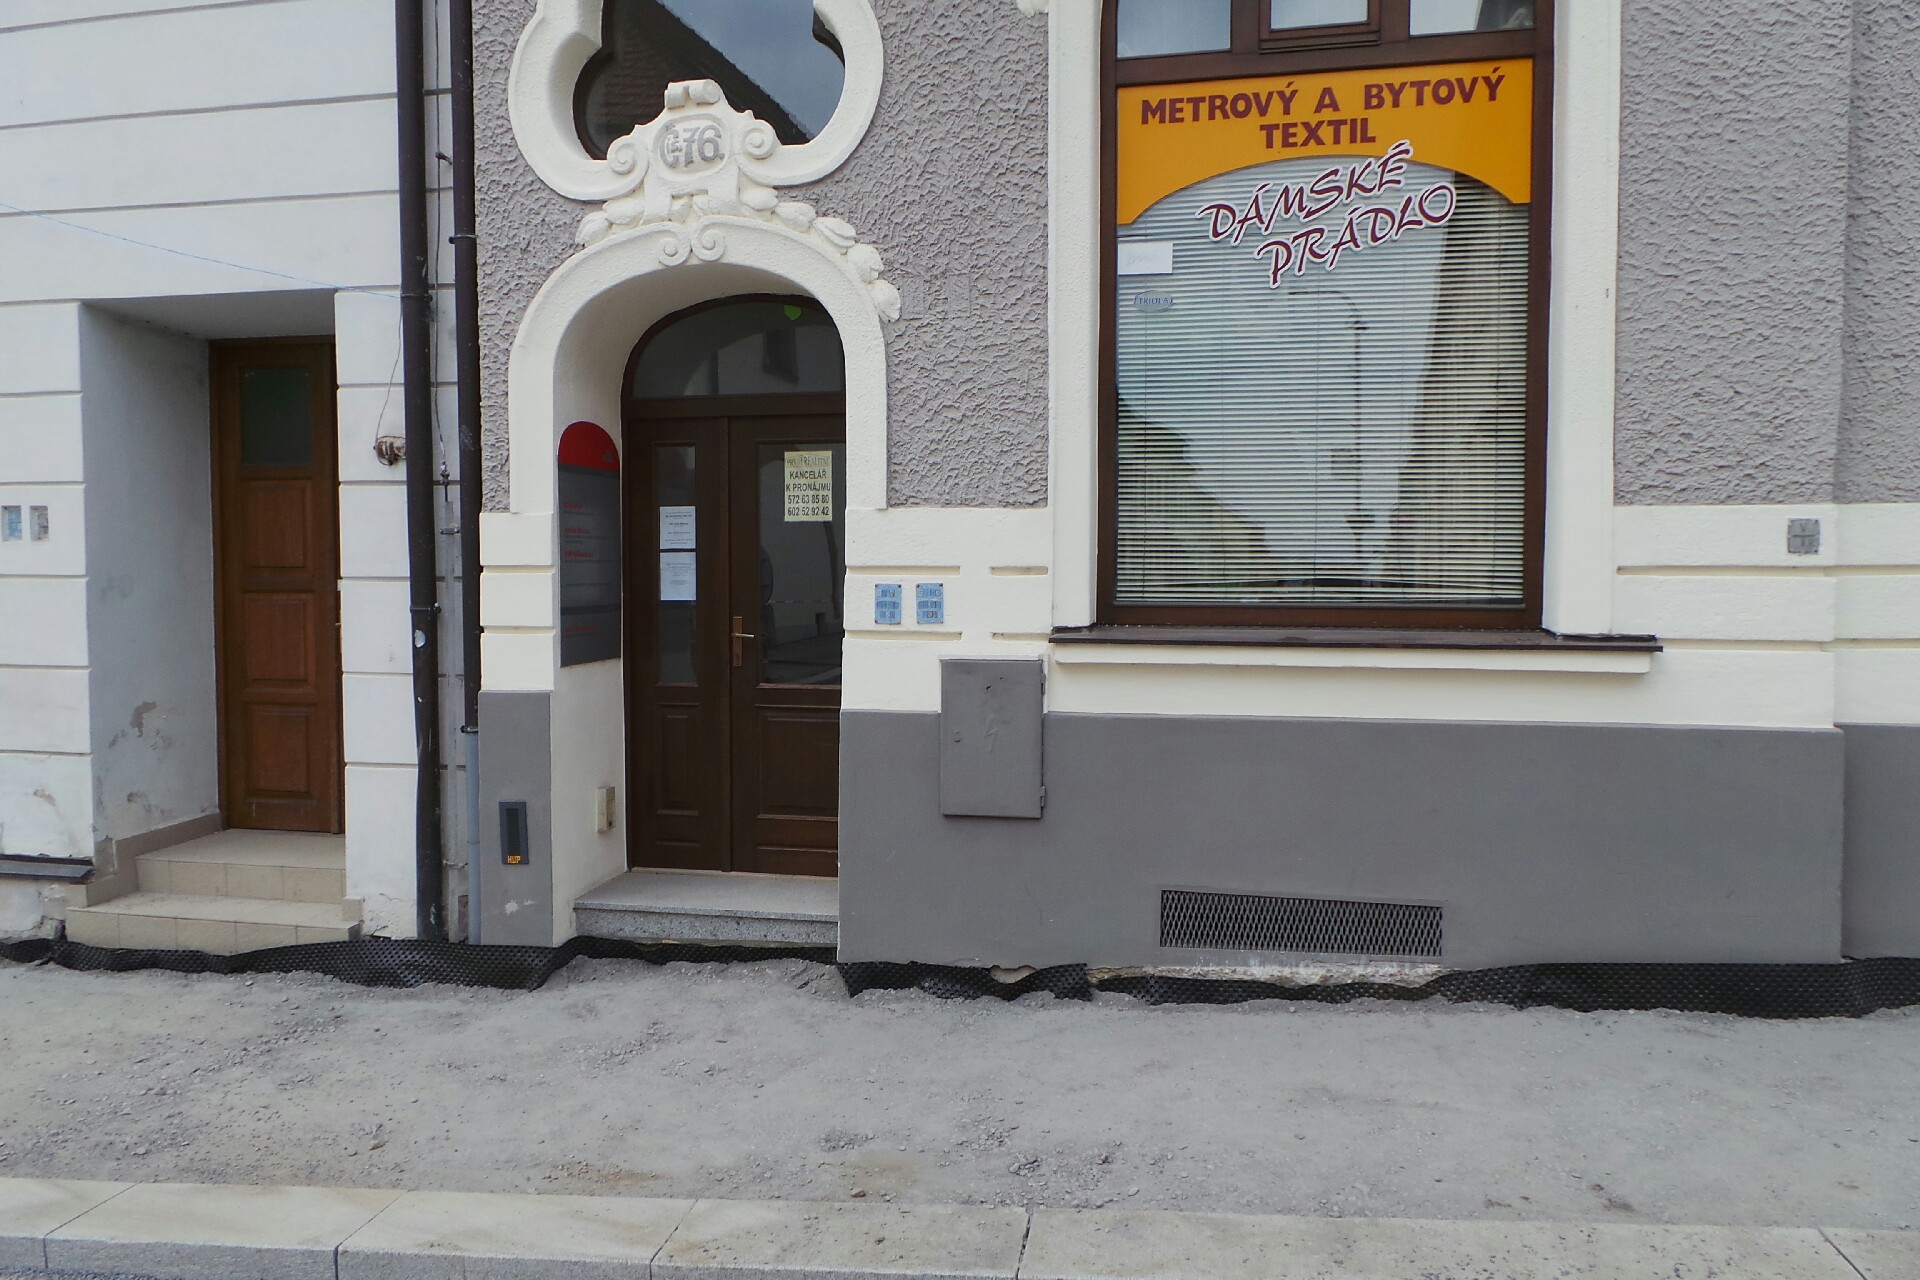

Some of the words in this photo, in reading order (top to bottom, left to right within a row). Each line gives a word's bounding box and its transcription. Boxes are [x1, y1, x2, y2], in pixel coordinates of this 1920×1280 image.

[1141, 80, 1299, 125] METROVÝ
[1314, 86, 1340, 114] A
[1364, 66, 1506, 111] BYTOVÝ
[1260, 117, 1376, 149] TEXTIL
[1197, 139, 1413, 244] DÁMSKÉ
[1255, 183, 1456, 287] PRÁDLO
[1138, 296, 1169, 305] TRIOLA
[789, 468, 827, 480] KANCELÁŘ
[786, 483, 791, 492] K
[792, 481, 831, 492] PRONÁJMU
[787, 494, 800, 504] 572
[801, 494, 810, 504] 63
[811, 494, 820, 504] 85
[821, 494, 830, 504] 80
[787, 506, 800, 516] 602
[801, 506, 810, 516] 52
[811, 506, 820, 516] 92
